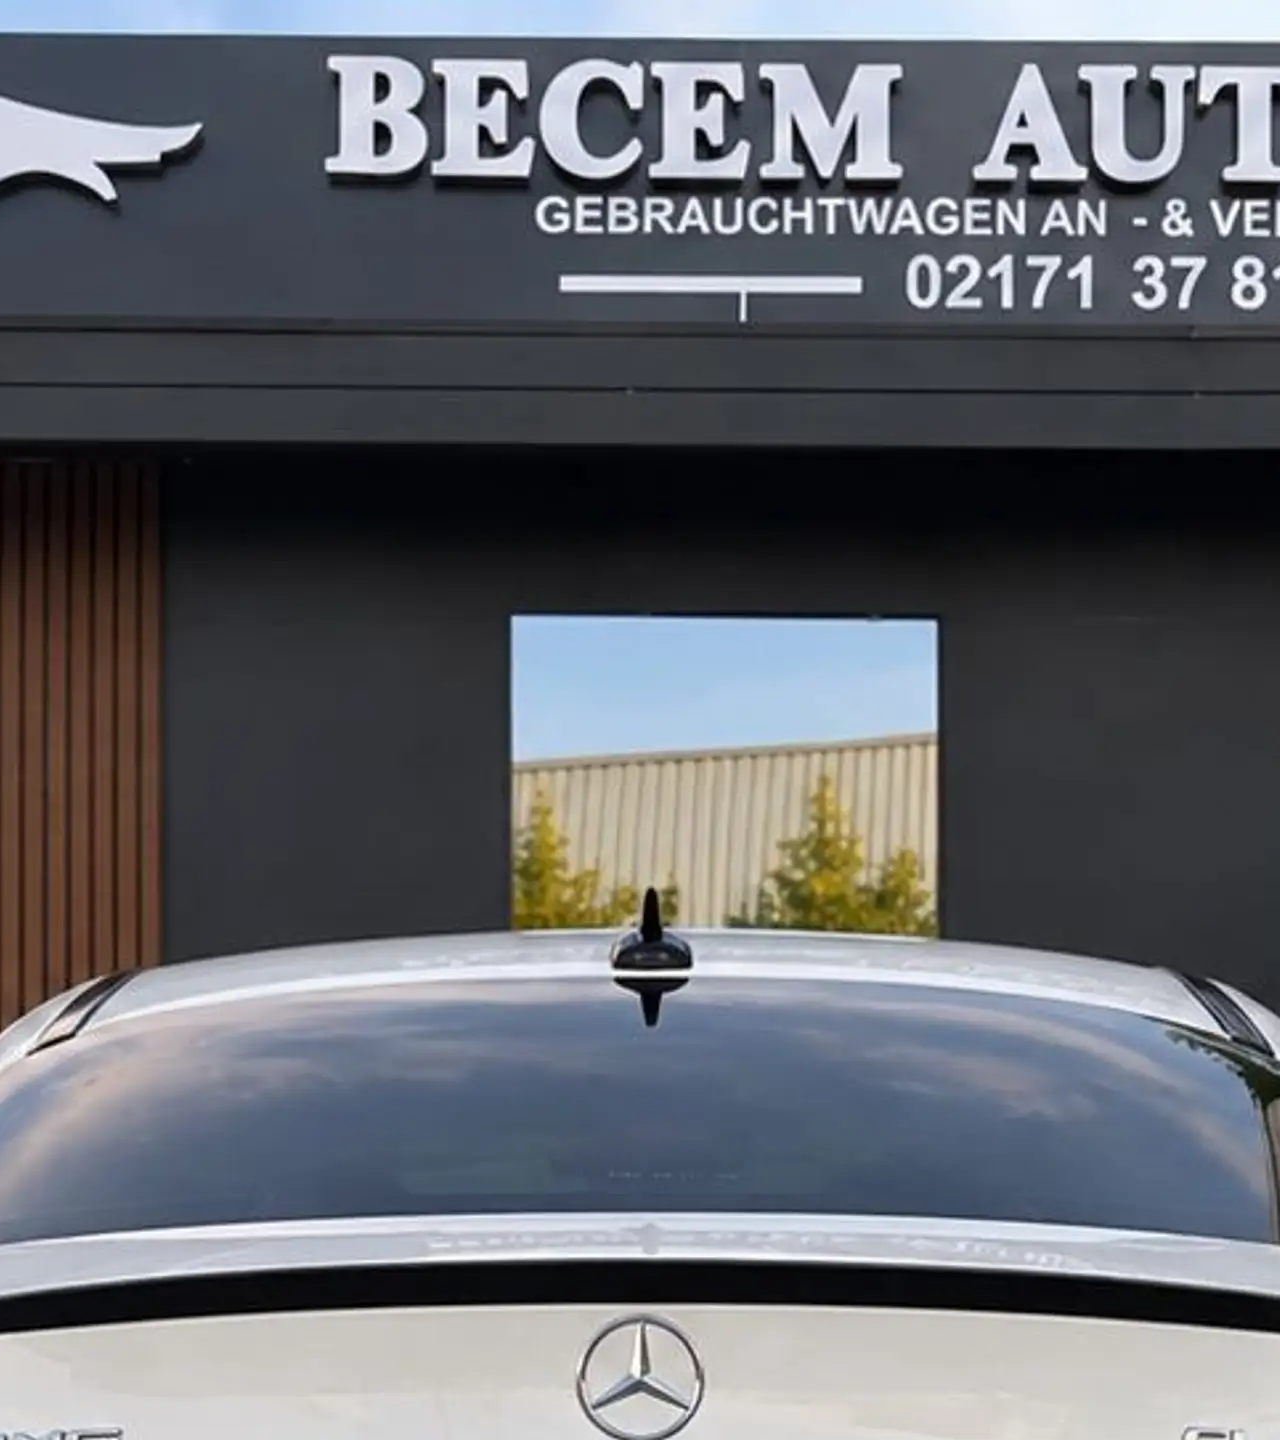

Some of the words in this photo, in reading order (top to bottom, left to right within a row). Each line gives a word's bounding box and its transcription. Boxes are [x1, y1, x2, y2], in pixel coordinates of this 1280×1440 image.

[324, 55, 904, 184] BECEM
[534, 194, 1027, 236] GEBRAUCHTWAGEN
[1039, 198, 1108, 237] AN
[1160, 197, 1196, 238] &
[905, 253, 1094, 310] 02171
[1130, 254, 1208, 311] 37
